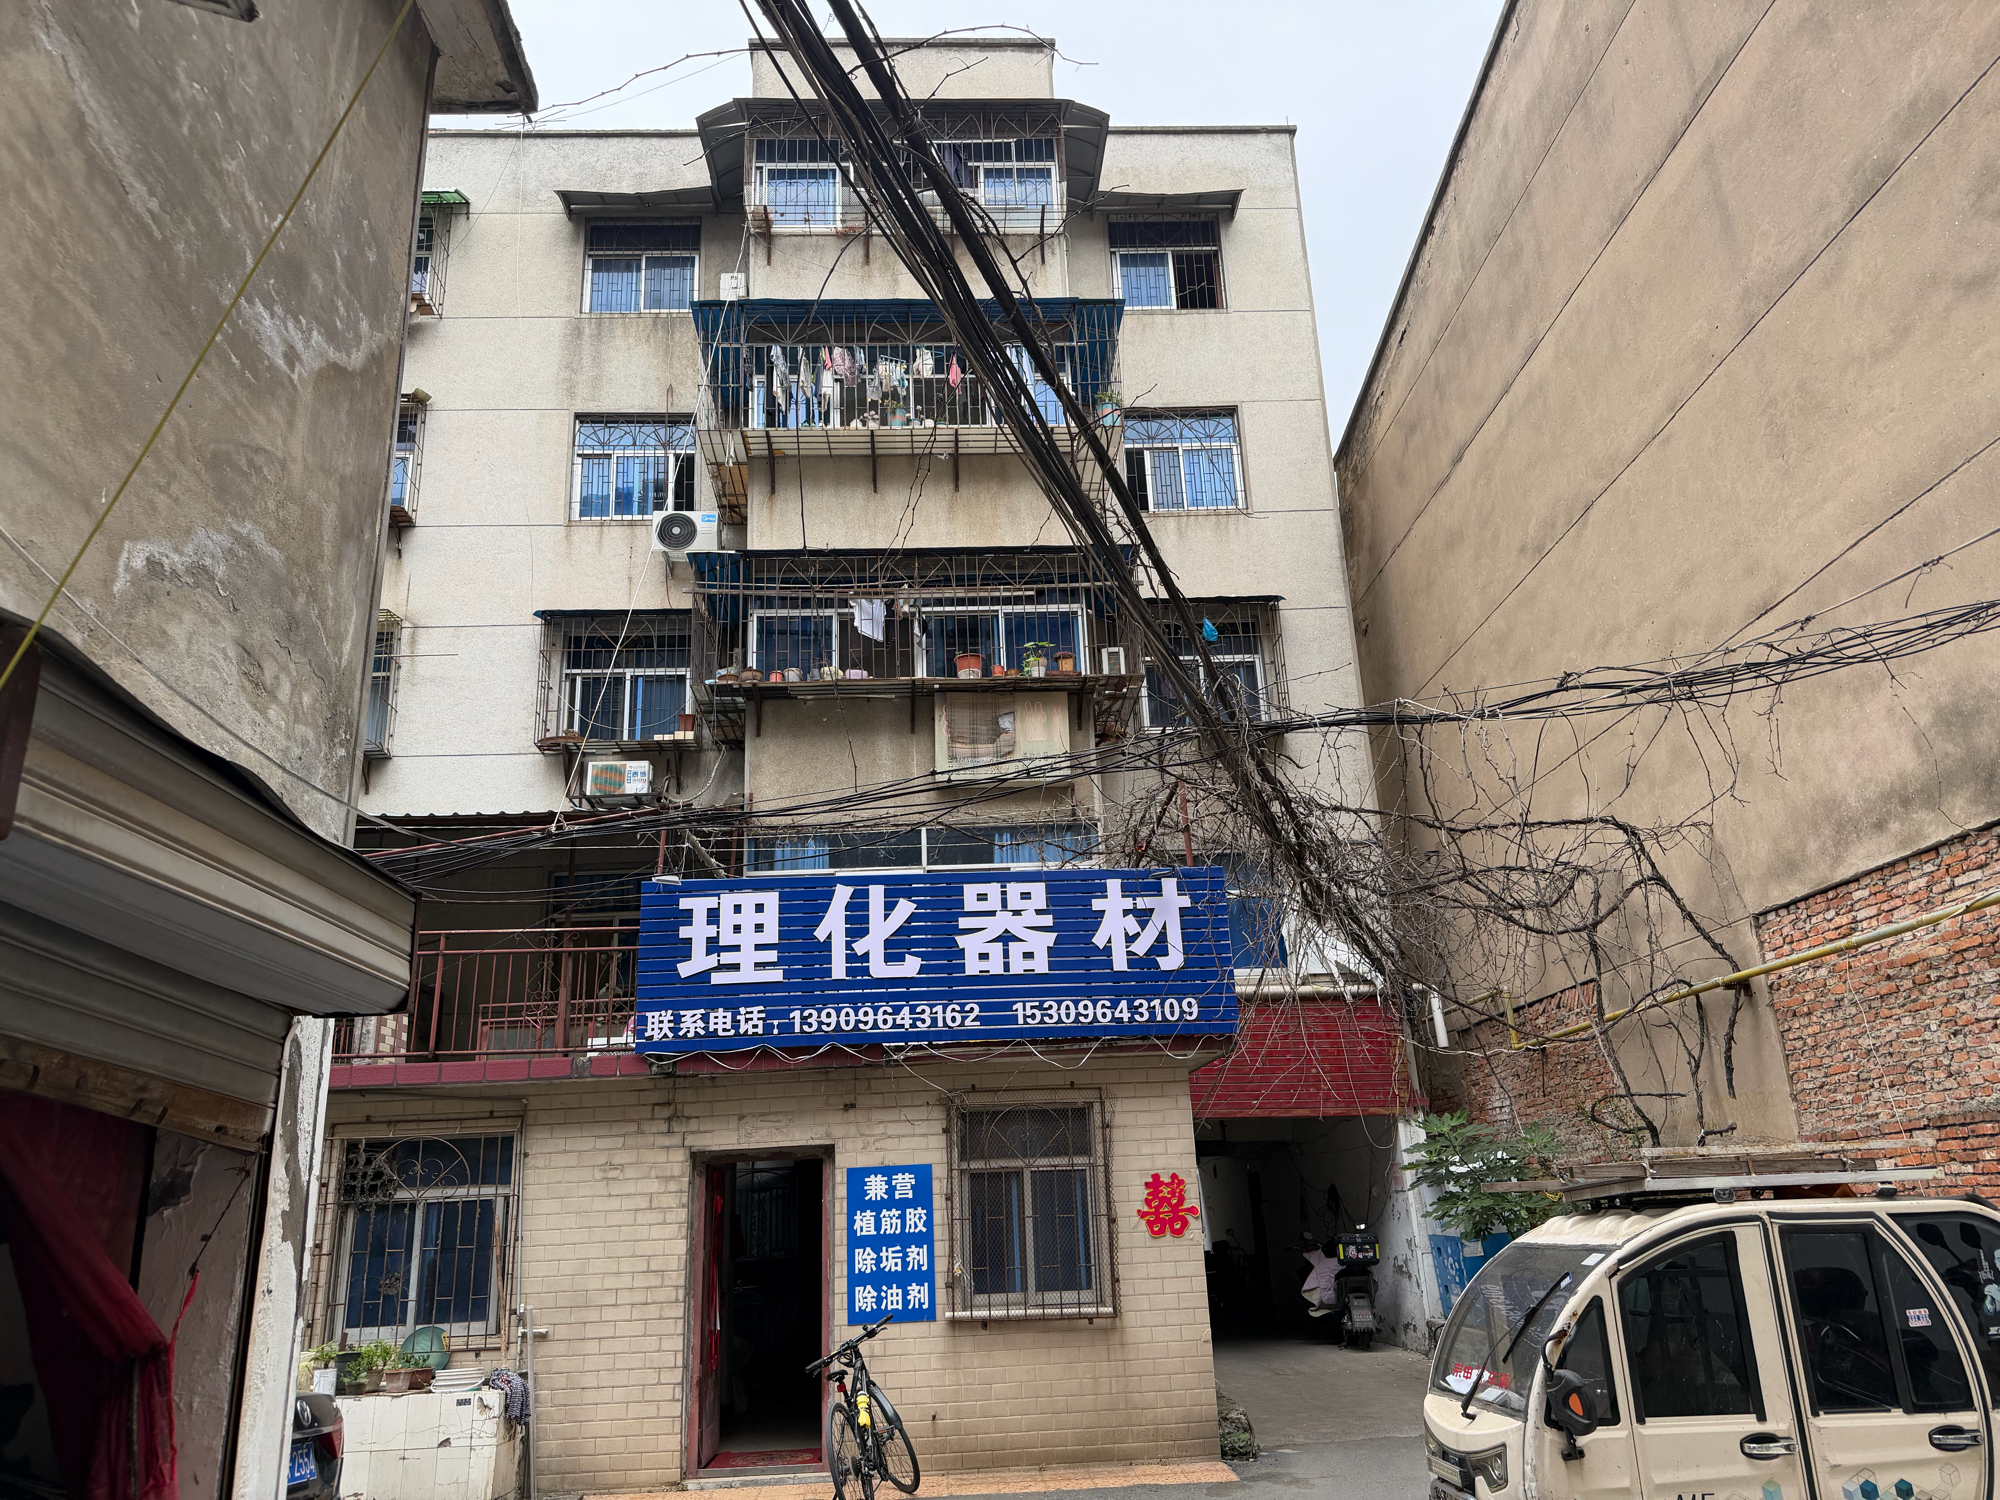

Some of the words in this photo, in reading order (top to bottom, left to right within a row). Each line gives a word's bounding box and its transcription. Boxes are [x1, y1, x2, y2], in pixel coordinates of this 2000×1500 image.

[677, 878, 1191, 985] 理化器材
[790, 1003, 981, 1033] 13909643162
[1012, 998, 1199, 1025] 15309643109
[864, 1173, 916, 1201] 兼营
[853, 1207, 928, 1236] 植筋胶
[854, 1244, 928, 1274] 除垢剂
[854, 1282, 929, 1312] 除油剂
